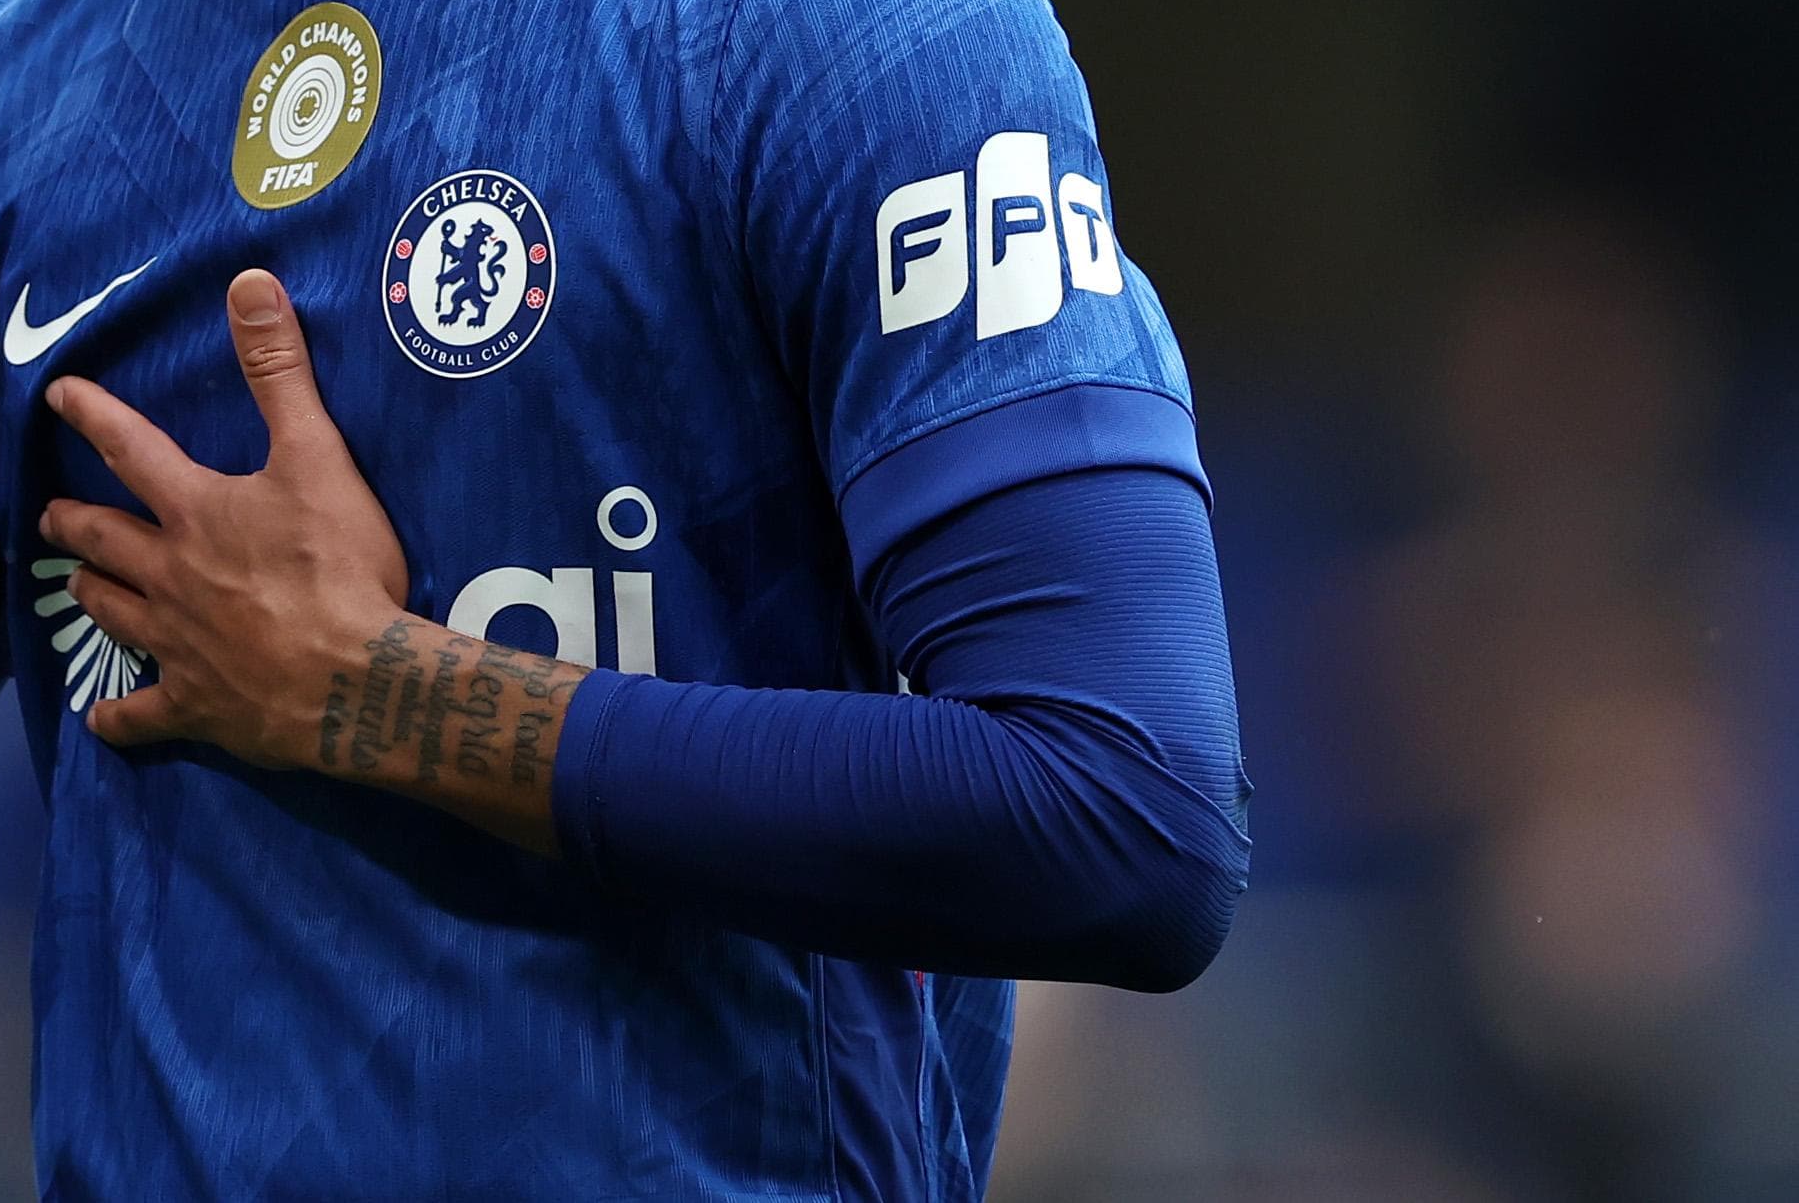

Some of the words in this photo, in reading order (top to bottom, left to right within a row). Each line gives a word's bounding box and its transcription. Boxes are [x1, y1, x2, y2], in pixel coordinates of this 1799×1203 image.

[247, 43, 296, 140] WORLD
[300, 22, 368, 123] CHAMPIONS
[259, 162, 314, 193] FIFA
[423, 178, 528, 222] CHELSEA
[405, 328, 473, 366] FOOTBALL
[481, 331, 519, 361] CLUB
